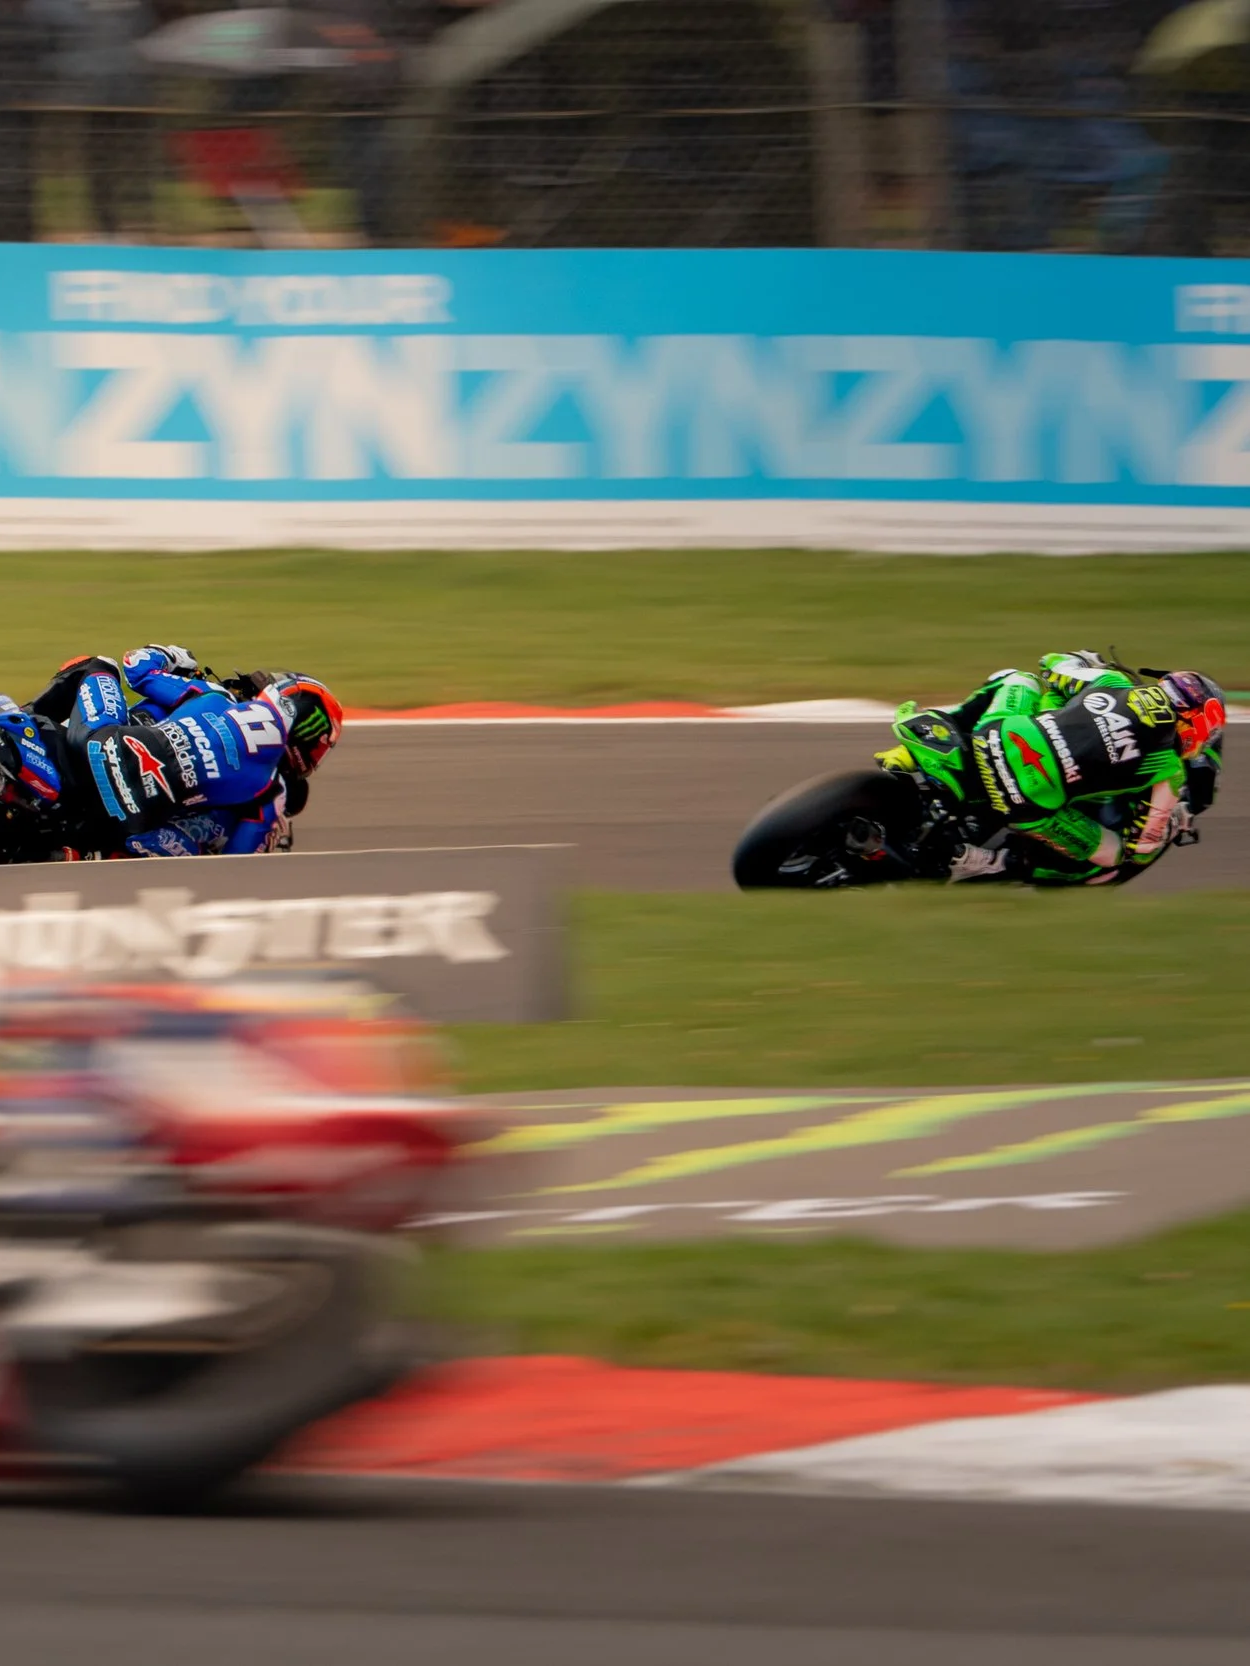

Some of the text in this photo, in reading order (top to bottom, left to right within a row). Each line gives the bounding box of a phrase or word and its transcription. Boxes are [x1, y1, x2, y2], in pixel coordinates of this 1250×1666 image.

[50, 332, 458, 480] ZYN
[442, 334, 800, 479] ZYN
[775, 335, 1180, 484] ZYN
[178, 716, 222, 779] DUCATI
[226, 702, 284, 755] 11
[1035, 713, 1084, 785] Kawasaki
[1093, 717, 1120, 765] STEELSTOCK
[103, 736, 141, 814] alpinestars
